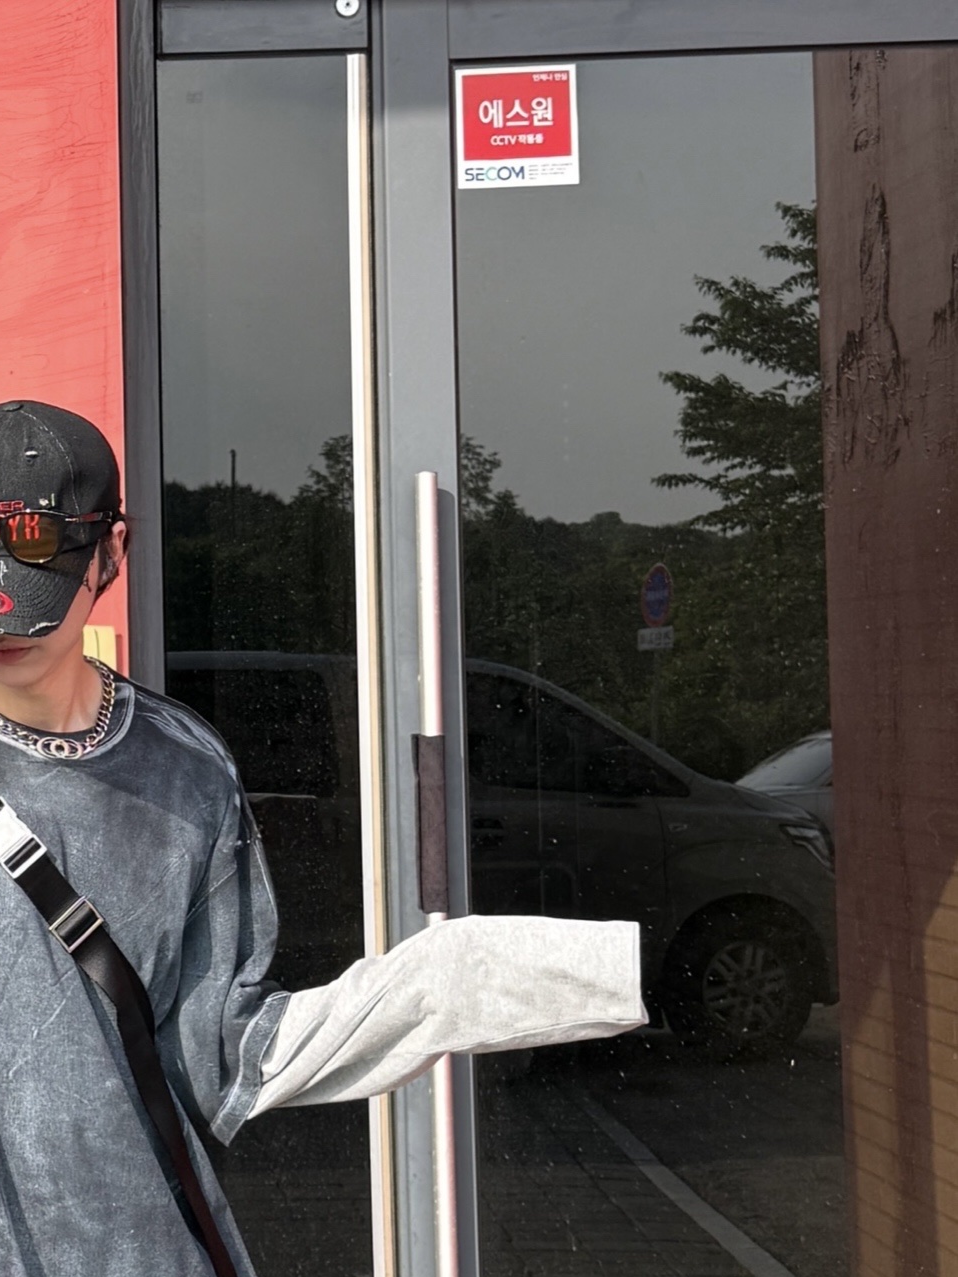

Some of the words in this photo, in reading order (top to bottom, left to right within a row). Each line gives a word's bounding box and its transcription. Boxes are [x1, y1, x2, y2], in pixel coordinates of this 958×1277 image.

[478, 97, 554, 128] 에스원
[490, 135, 517, 146] CCTV
[464, 166, 525, 182] SECOM
